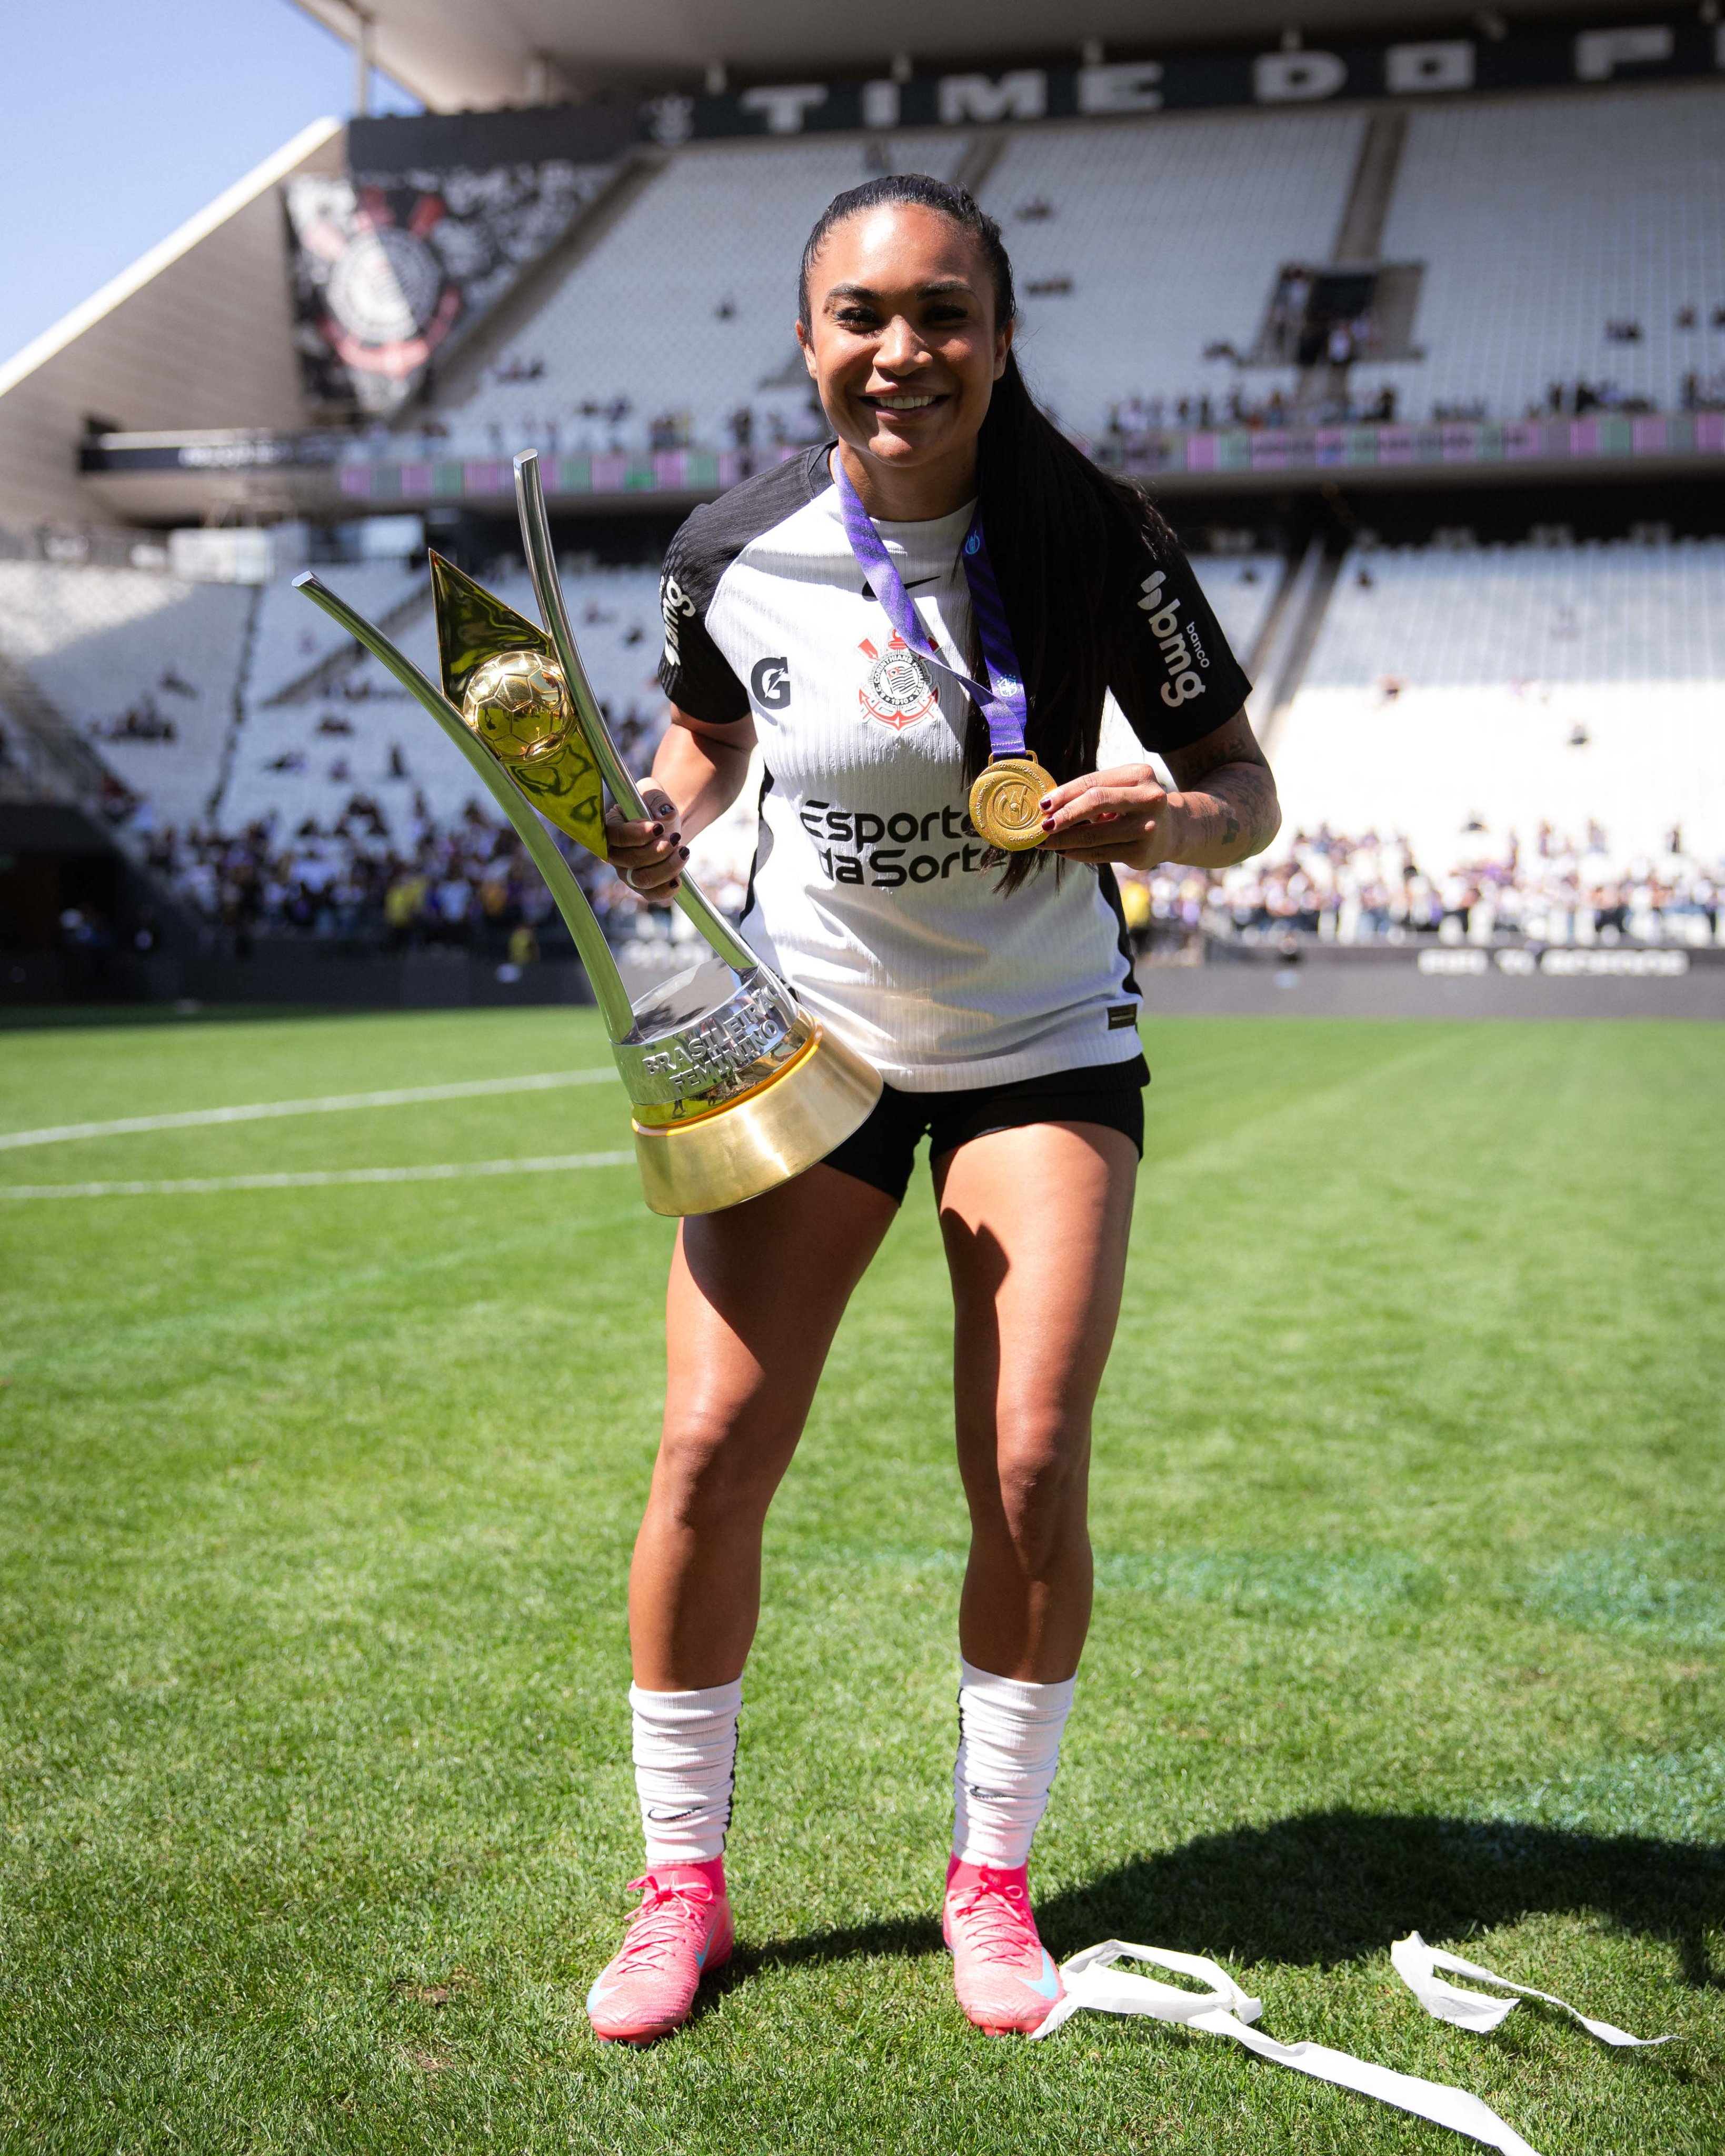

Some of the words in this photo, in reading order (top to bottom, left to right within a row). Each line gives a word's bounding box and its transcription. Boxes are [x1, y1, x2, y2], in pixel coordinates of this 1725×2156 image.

[739, 59, 1163, 134] TIME
[1253, 38, 1476, 102] DO
[874, 654, 913, 683] CORINTHIANS
[912, 662, 924, 696] PAULISTA
[1148, 598, 1206, 707] bmg
[1186, 621, 1210, 668] banco
[751, 657, 791, 710] G
[669, 1019, 780, 1095] FEMININO
